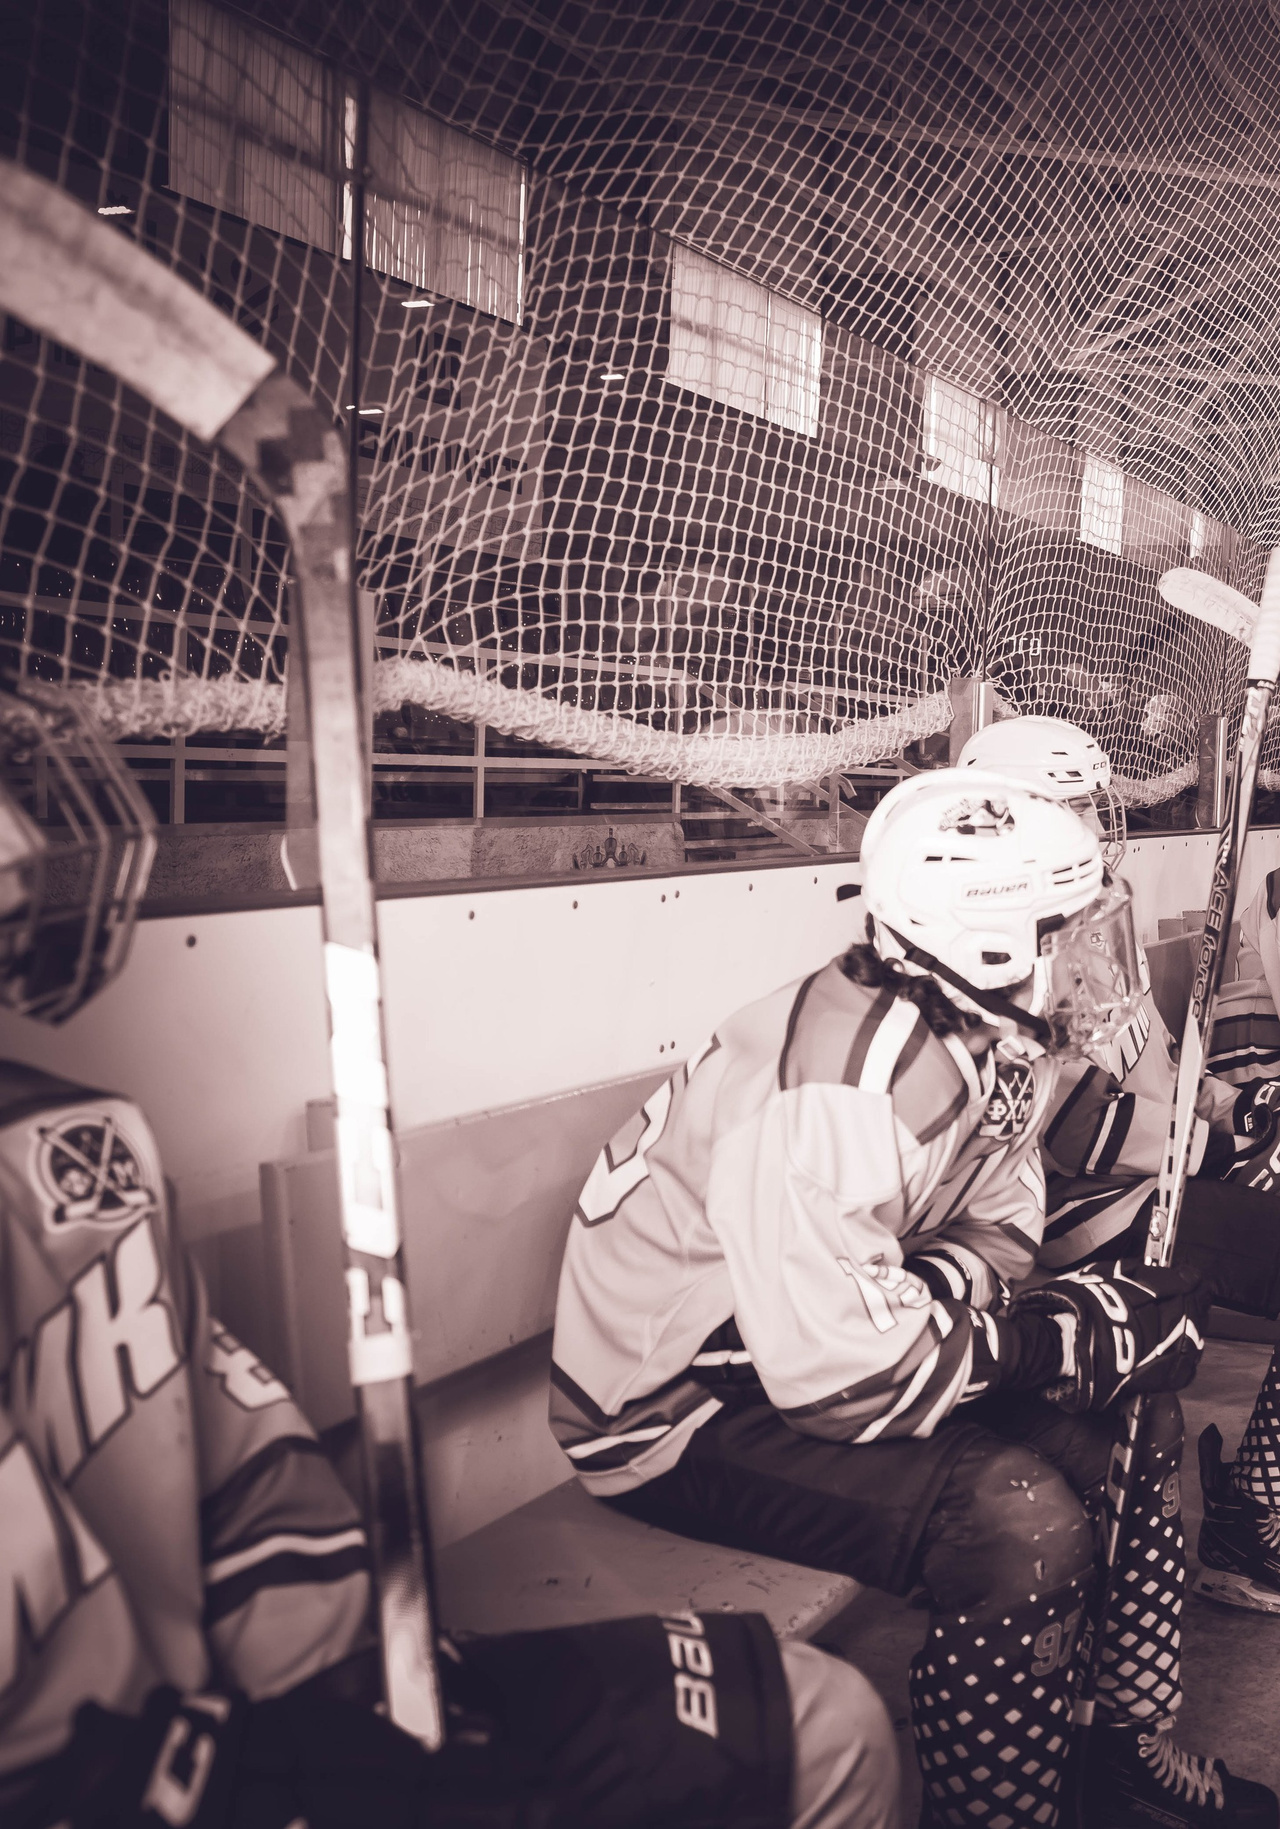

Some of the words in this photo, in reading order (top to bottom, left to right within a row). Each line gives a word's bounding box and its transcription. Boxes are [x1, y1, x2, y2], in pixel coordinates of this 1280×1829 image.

[966, 882, 1028, 898] BAUER
[1208, 870, 1231, 932] ACE
[1191, 932, 1220, 1021] force
[667, 1608, 720, 1738] BAU
